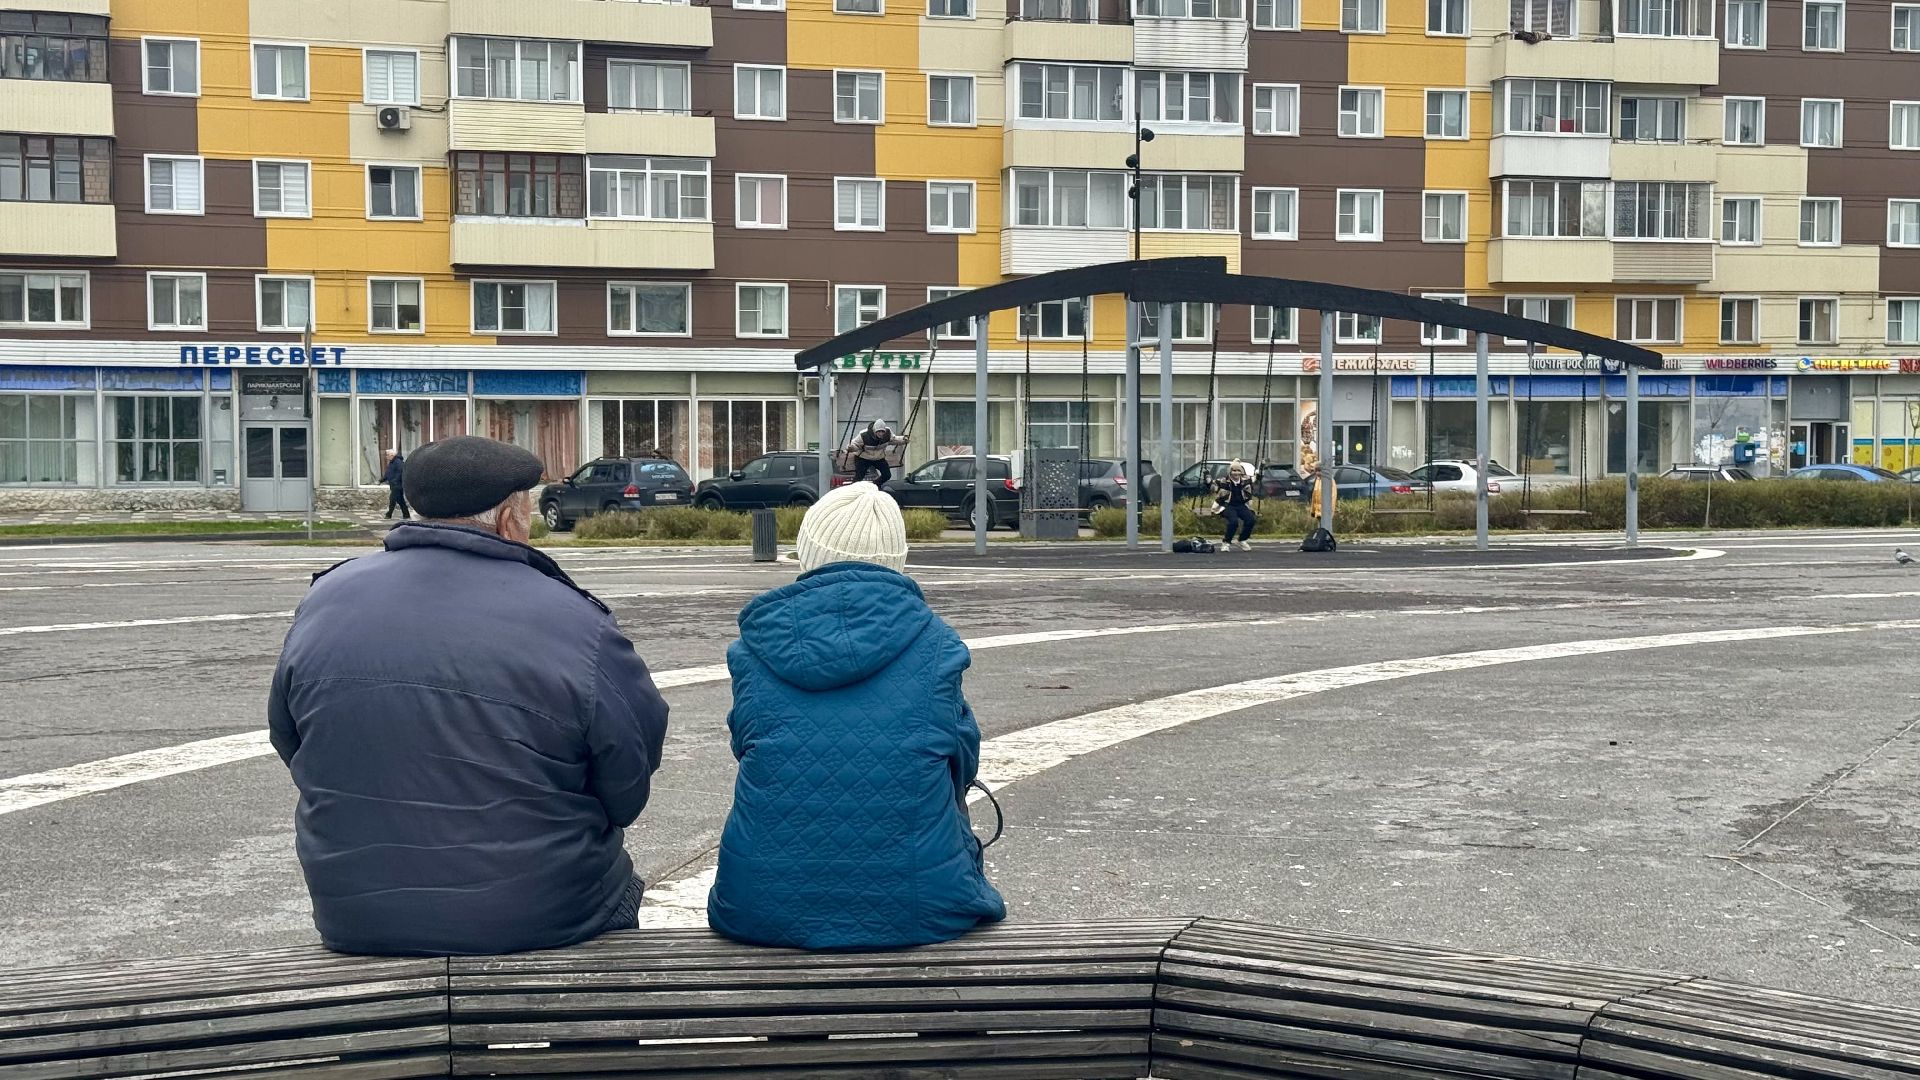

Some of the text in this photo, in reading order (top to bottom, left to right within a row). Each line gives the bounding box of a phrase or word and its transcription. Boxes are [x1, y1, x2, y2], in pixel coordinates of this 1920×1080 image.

[180, 346, 346, 365] ПЕРЕСВЕТ
[830, 354, 920, 369] ВЕТЫ
[1319, 357, 1415, 370] ЕЖИЙ ХЛЕБ
[1533, 359, 1563, 369] ПОЧТА
[1705, 358, 1778, 369] WILDBERRIES
